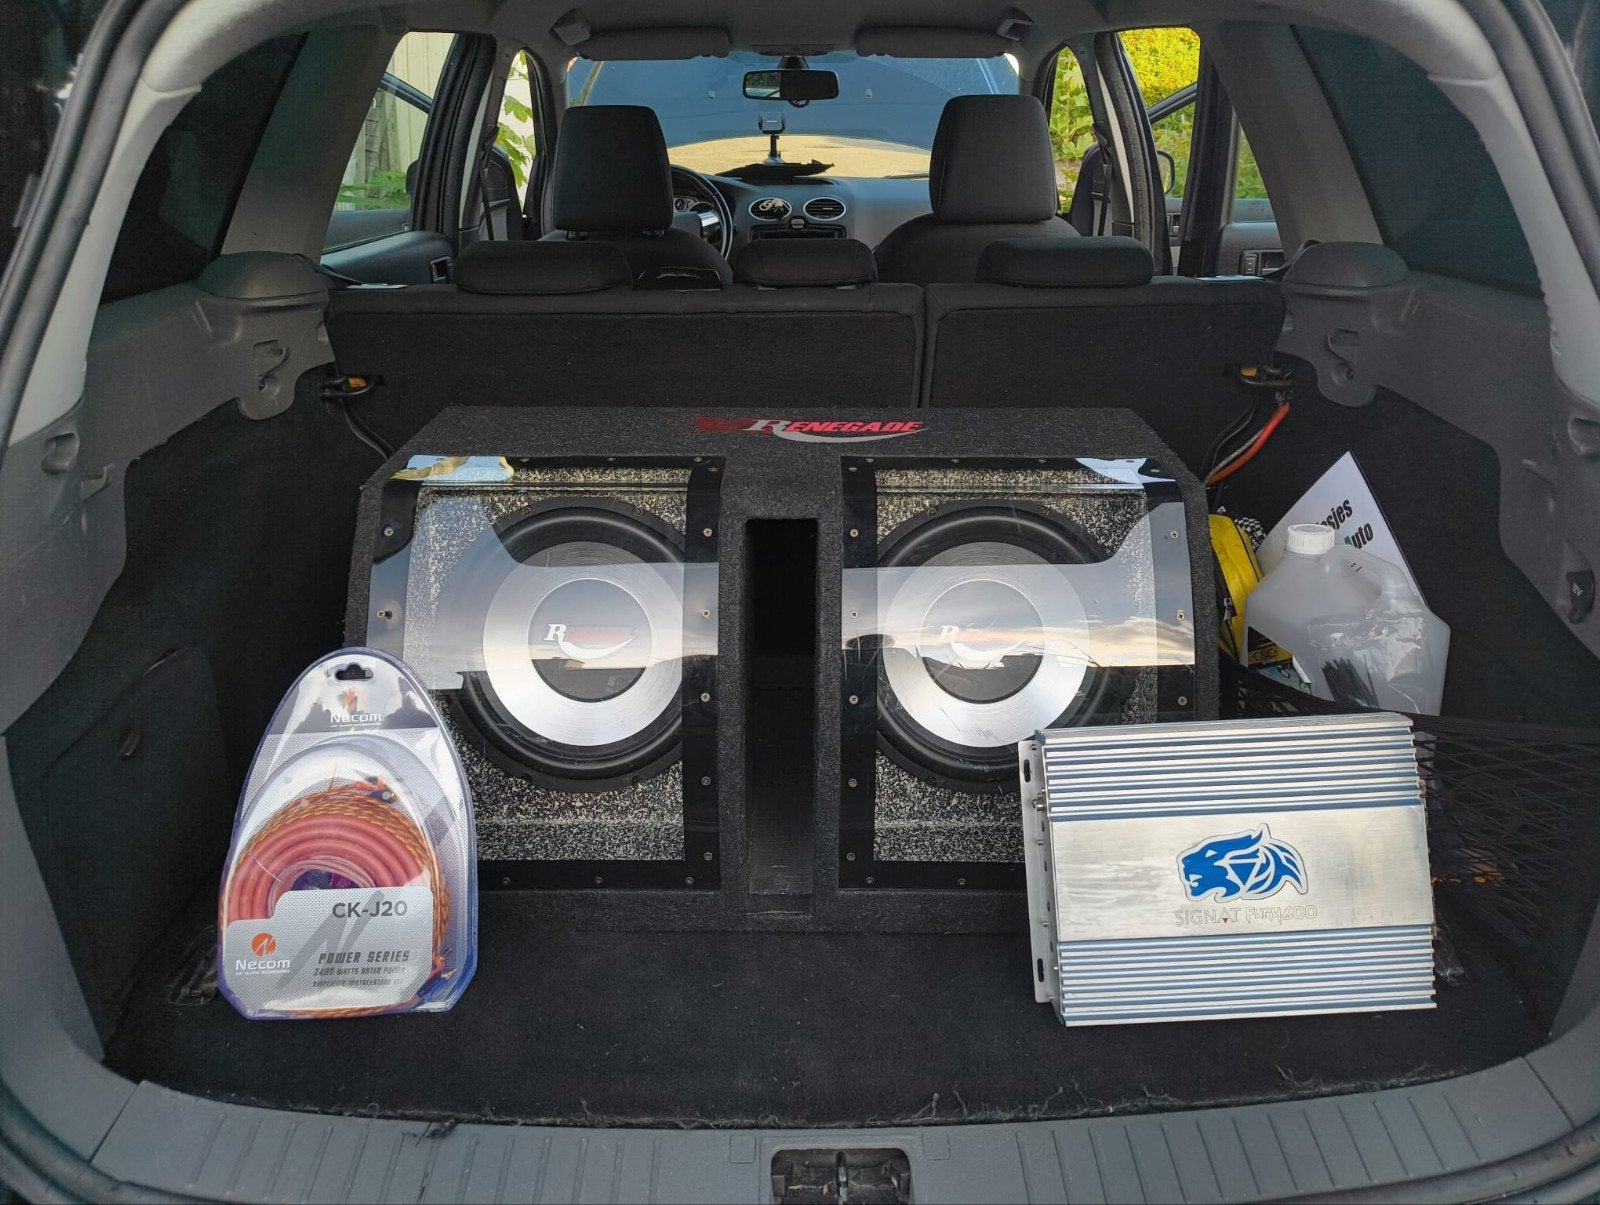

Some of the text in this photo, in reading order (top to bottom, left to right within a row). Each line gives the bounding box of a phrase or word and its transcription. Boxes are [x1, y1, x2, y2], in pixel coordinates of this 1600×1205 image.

[741, 419, 924, 436] RENEGADE
[330, 713, 382, 723] Necom
[332, 900, 408, 919] CK-J20
[1174, 907, 1241, 927] SIGNAT
[318, 950, 410, 964] POWER SERIES
[235, 959, 291, 971] Necom
